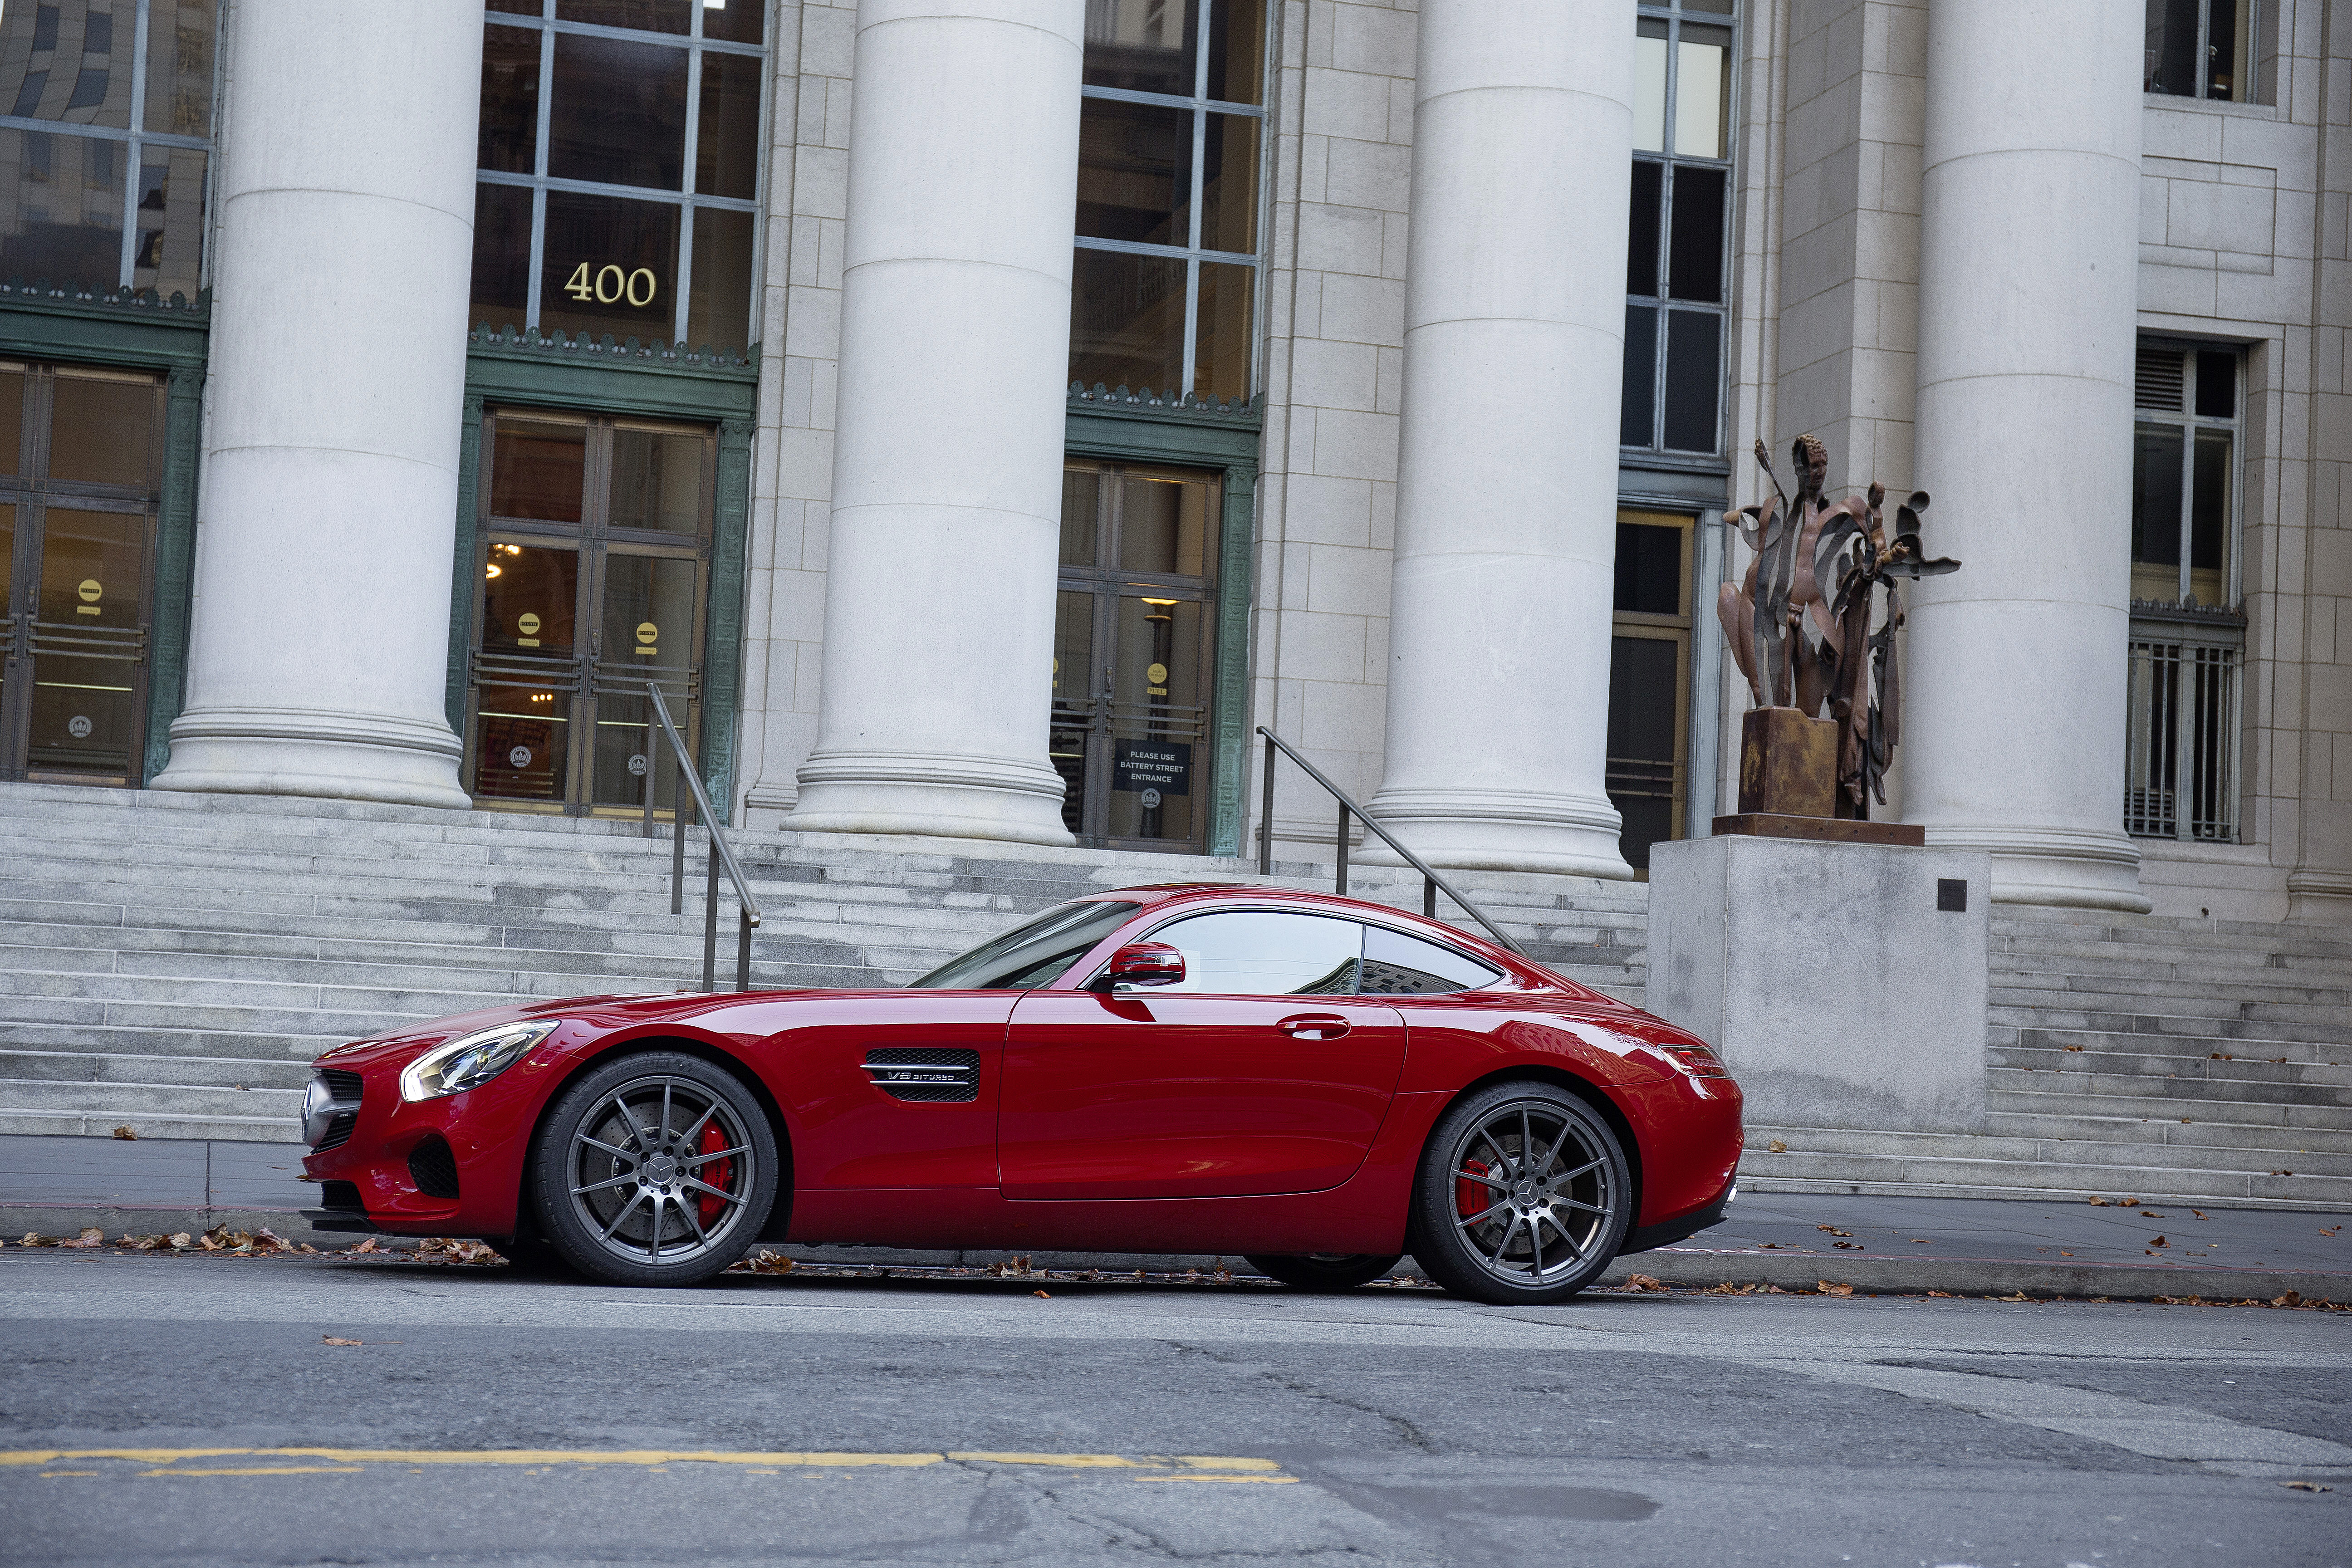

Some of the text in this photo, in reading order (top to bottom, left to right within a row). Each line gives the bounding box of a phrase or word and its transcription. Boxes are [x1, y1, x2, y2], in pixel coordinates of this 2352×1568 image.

[564, 261, 657, 307] 400
[1130, 751, 1159, 760] PLEASE
[1120, 761, 1184, 773] BATTERY STREET
[1131, 773, 1172, 783] ENTRANCE
[1460, 1098, 1491, 1125] MICHELIN
